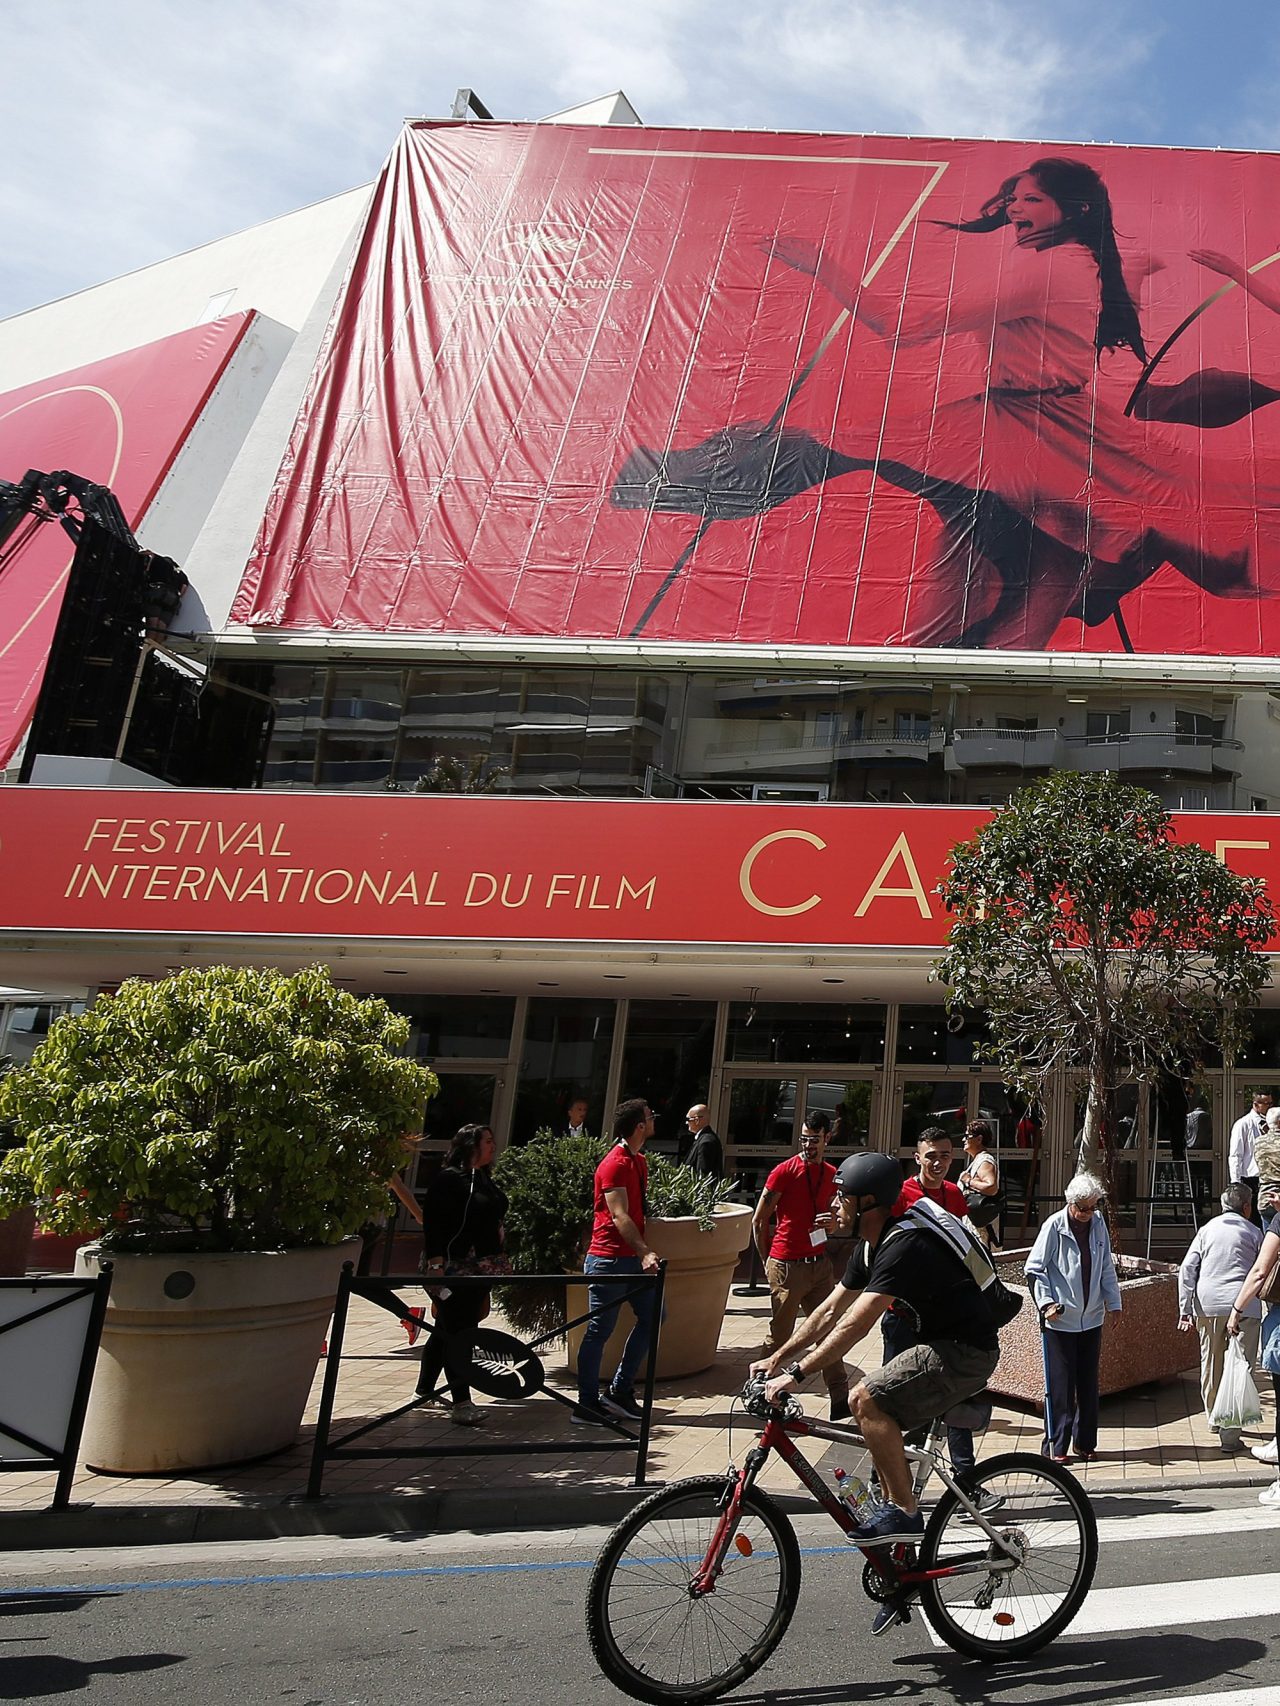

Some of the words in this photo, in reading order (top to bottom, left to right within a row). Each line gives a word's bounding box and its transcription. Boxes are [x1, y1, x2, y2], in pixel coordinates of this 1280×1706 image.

[562, 277, 634, 291] CANNES
[509, 297, 544, 308] MAI
[547, 297, 594, 309] 2017
[84, 819, 291, 856] FESTIVAL
[64, 864, 447, 906] INTERNATIONAL
[463, 873, 533, 908] DU
[546, 875, 657, 910] FILM
